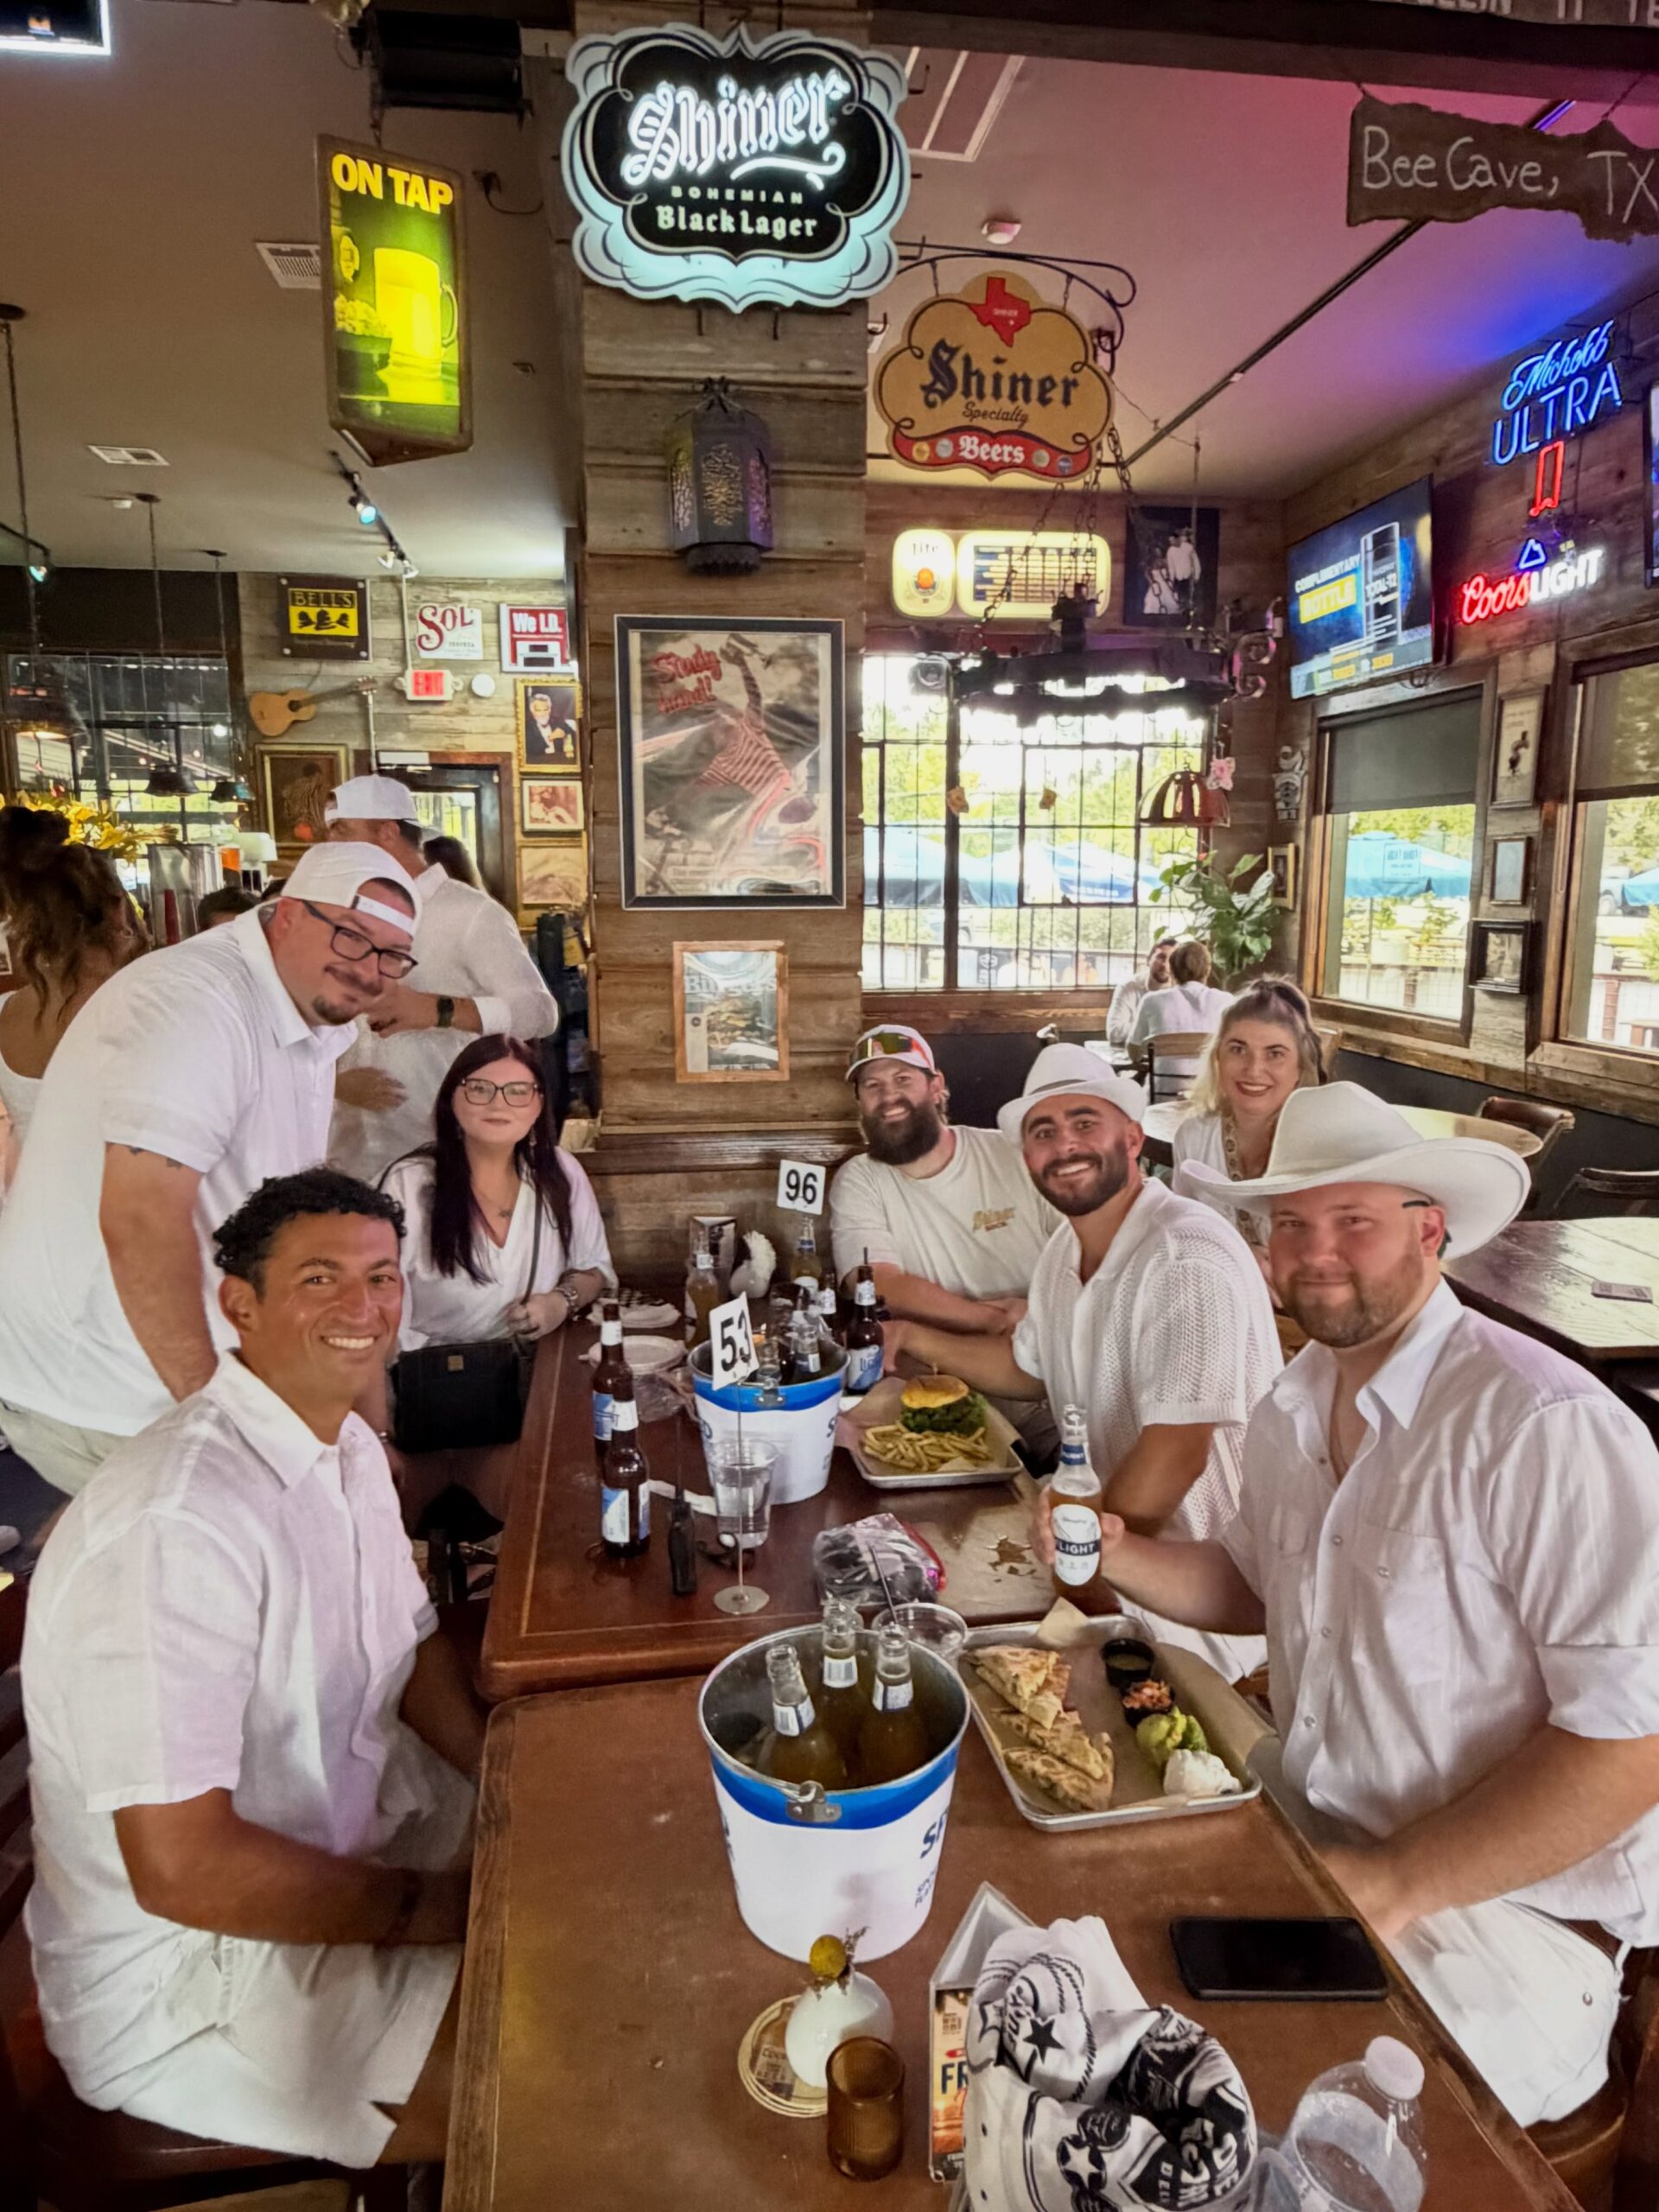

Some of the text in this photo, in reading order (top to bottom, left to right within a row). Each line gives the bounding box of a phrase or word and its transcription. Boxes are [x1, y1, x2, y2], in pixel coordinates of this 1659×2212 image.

[622, 69, 850, 188] Shiner
[332, 153, 454, 215] ON TAP
[671, 185, 804, 205] BOHEMIAN
[1362, 125, 1659, 224] Bee Cave, TX
[656, 205, 817, 241] Black Lager
[919, 337, 1080, 410] Shiner
[961, 400, 1030, 430] Specialty
[1491, 361, 1623, 465] ULTRA
[958, 435, 1026, 465] Beers
[1460, 548, 1604, 625] Coors LIGHT
[416, 605, 474, 652] SOL
[512, 612, 537, 633] We
[785, 1168, 817, 1205] 96
[721, 1309, 752, 1372] 53
[1058, 1541, 1096, 1555] LIGHT
